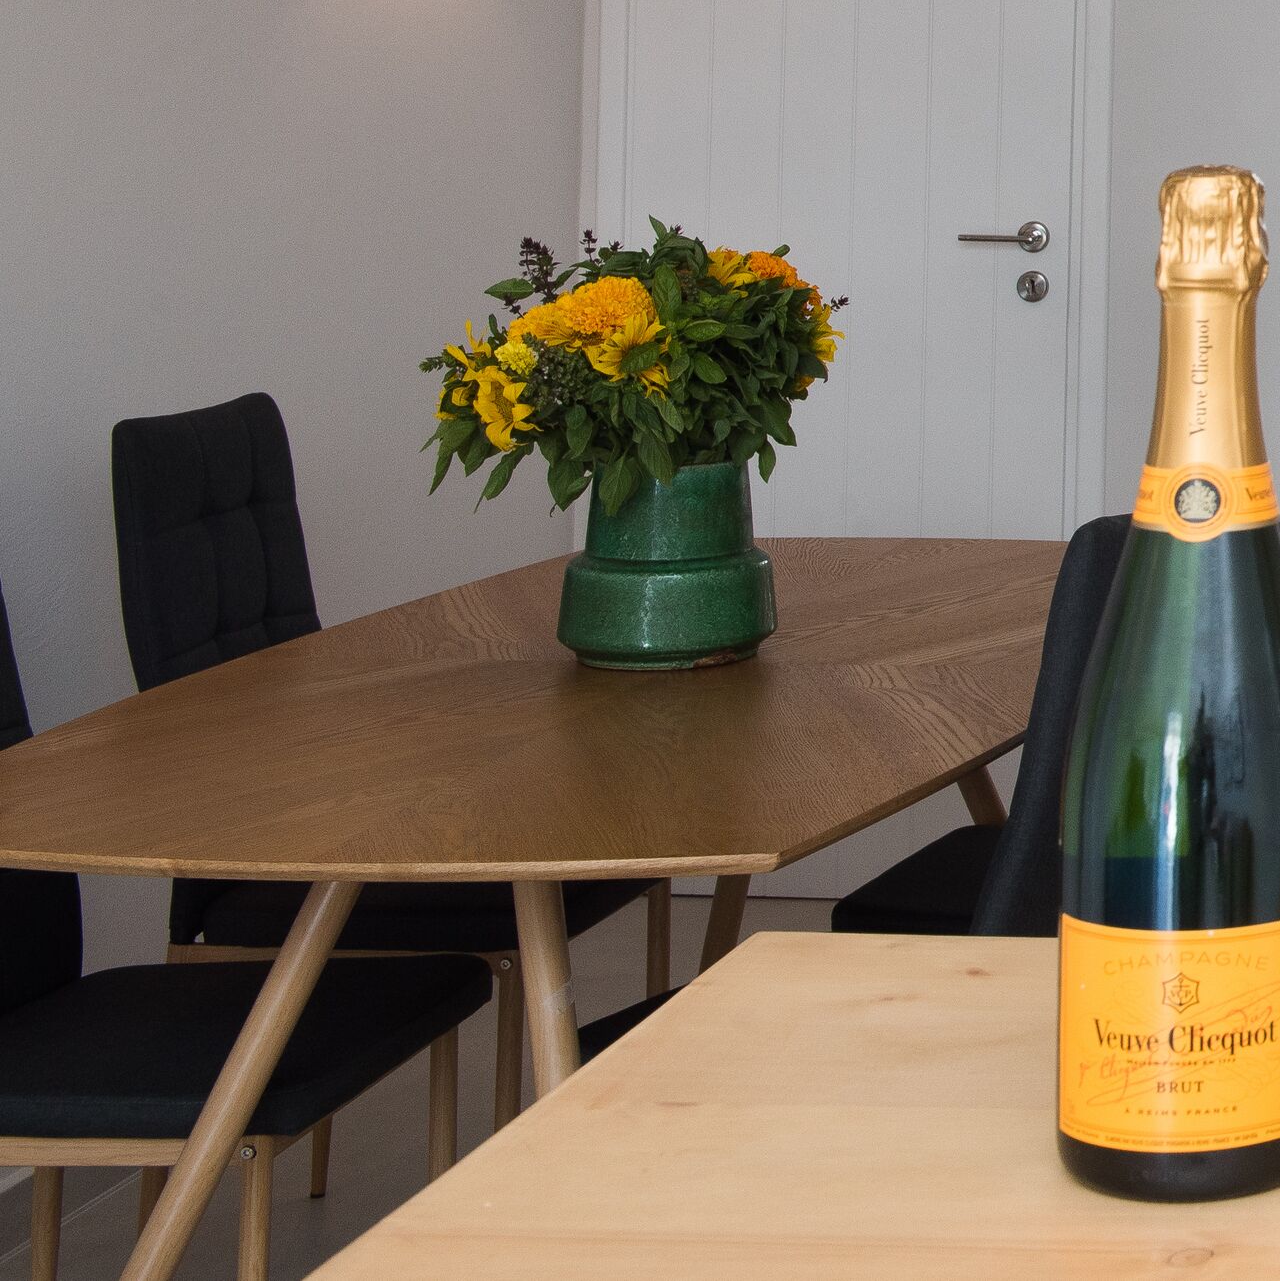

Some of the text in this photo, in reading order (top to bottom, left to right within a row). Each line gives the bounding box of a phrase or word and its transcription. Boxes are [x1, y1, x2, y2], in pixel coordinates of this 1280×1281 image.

[1188, 319, 1214, 437] Veuve Clicquot
[1103, 950, 1270, 976] CHAMPAGNE
[1093, 1018, 1278, 1055] Veuve Clicquot
[1156, 1080, 1205, 1094] BRUT
